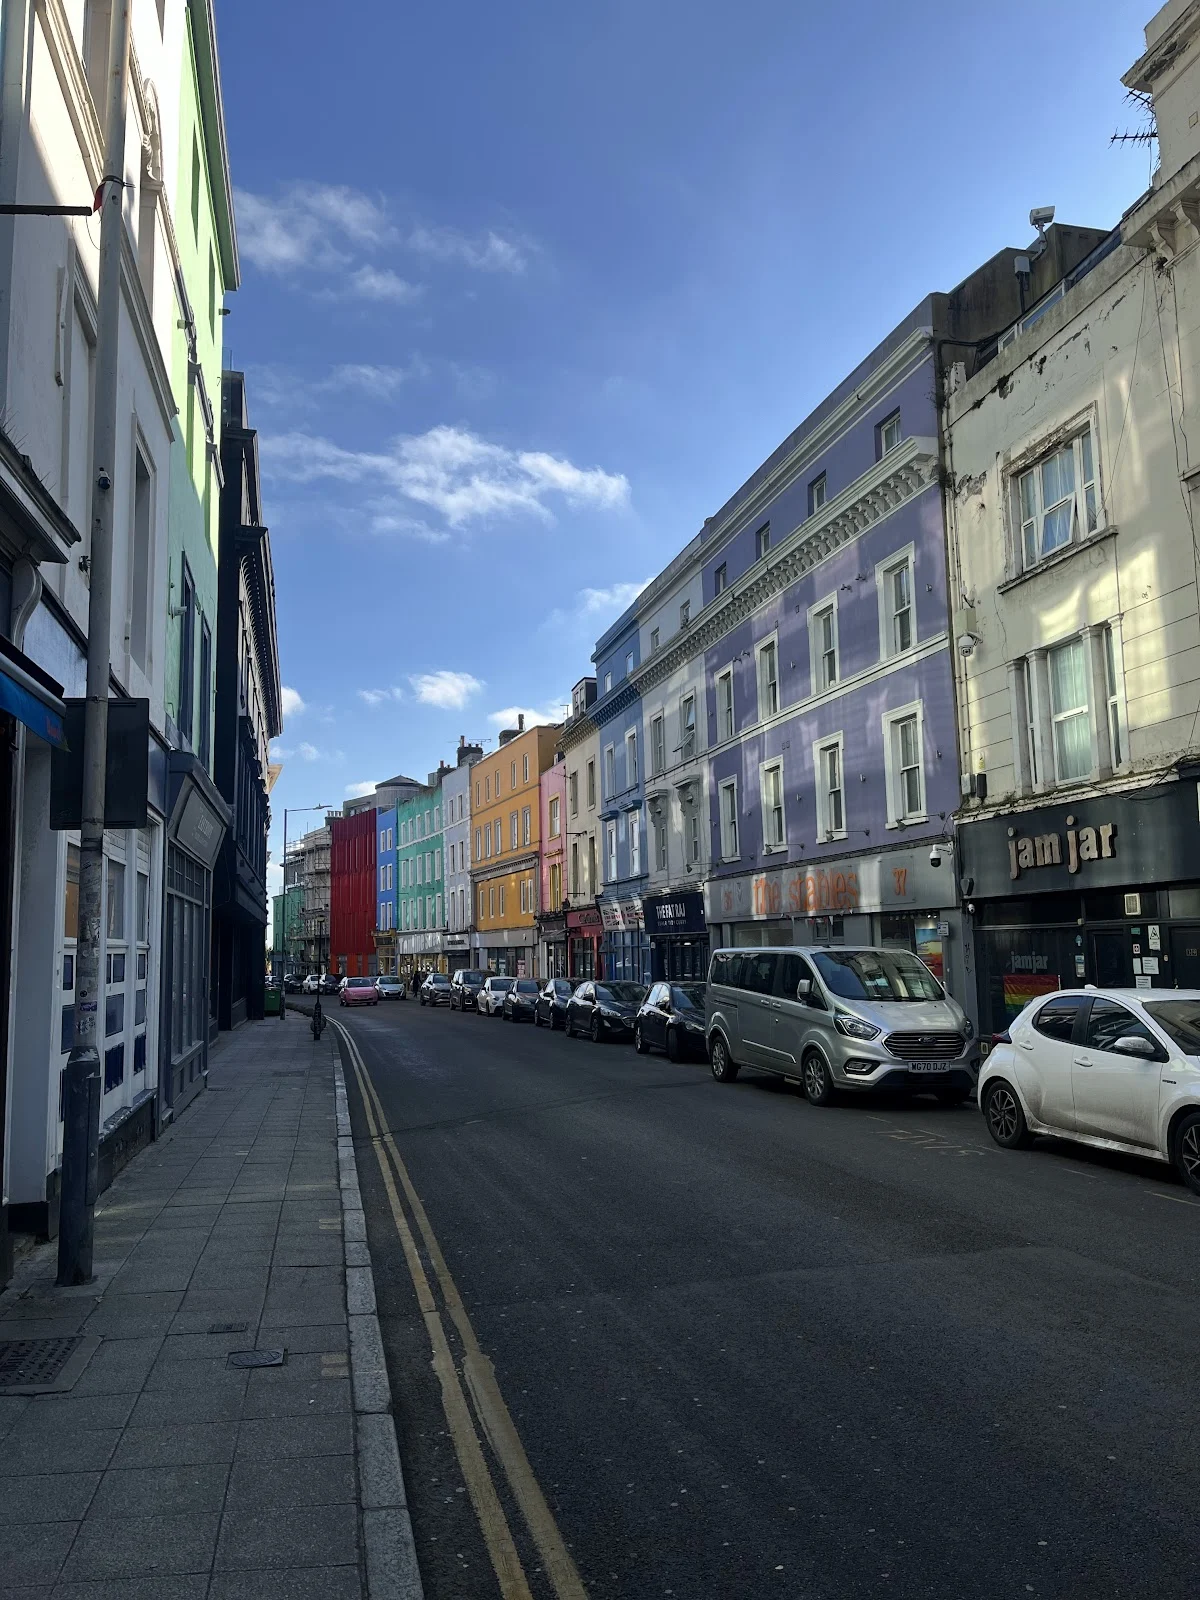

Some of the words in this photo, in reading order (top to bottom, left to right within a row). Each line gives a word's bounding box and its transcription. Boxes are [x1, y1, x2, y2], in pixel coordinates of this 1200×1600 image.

[1007, 827, 1061, 880] jam
[1066, 815, 1114, 873] jar
[753, 876, 781, 915] the
[788, 868, 858, 913] stables
[655, 905, 665, 919] THE
[665, 904, 675, 918] FAT
[932, 1062, 947, 1071] DJZ
